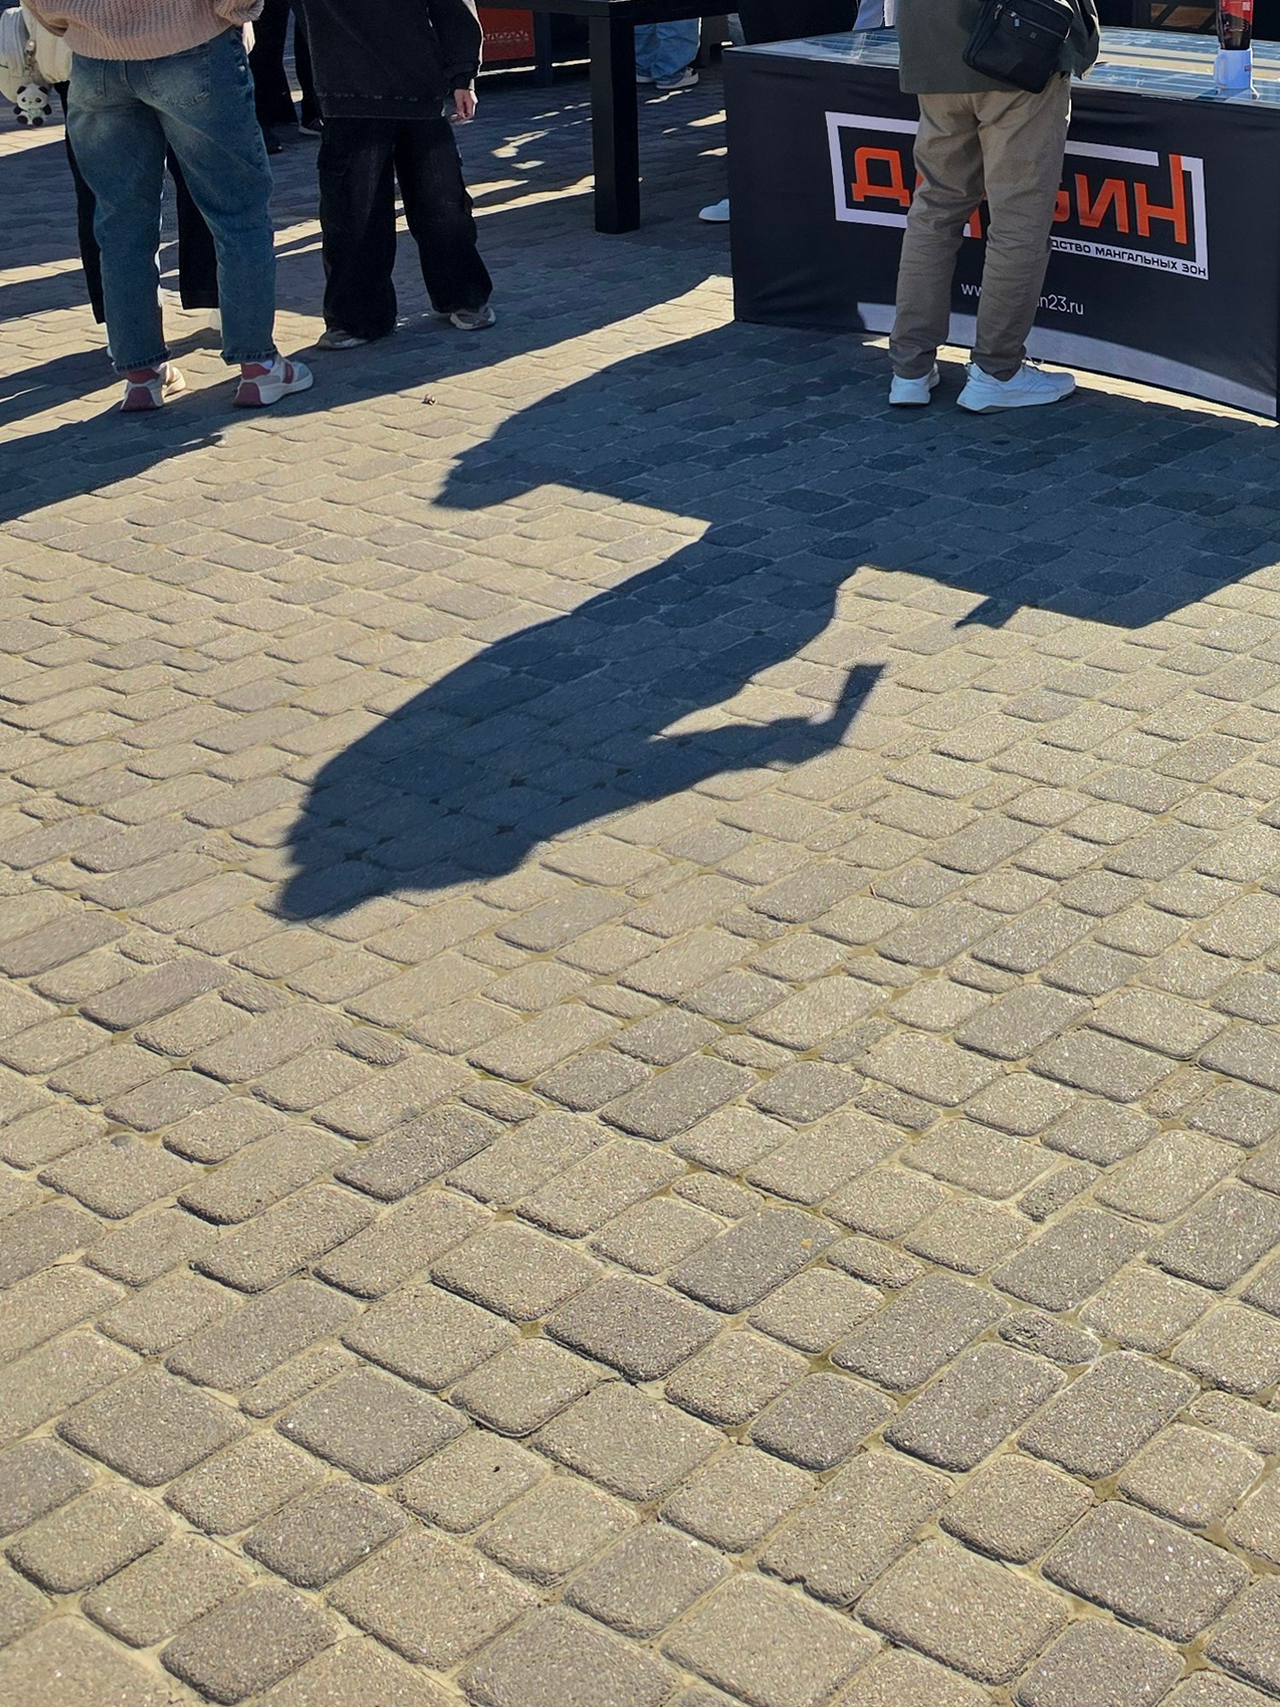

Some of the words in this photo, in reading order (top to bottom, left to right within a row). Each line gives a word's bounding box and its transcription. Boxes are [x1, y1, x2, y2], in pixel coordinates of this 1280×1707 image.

[851, 145, 1188, 244] ДИН
[1095, 246, 1178, 270] МАНГАЛЬНЫХ
[1181, 262, 1207, 277] ЗОН
